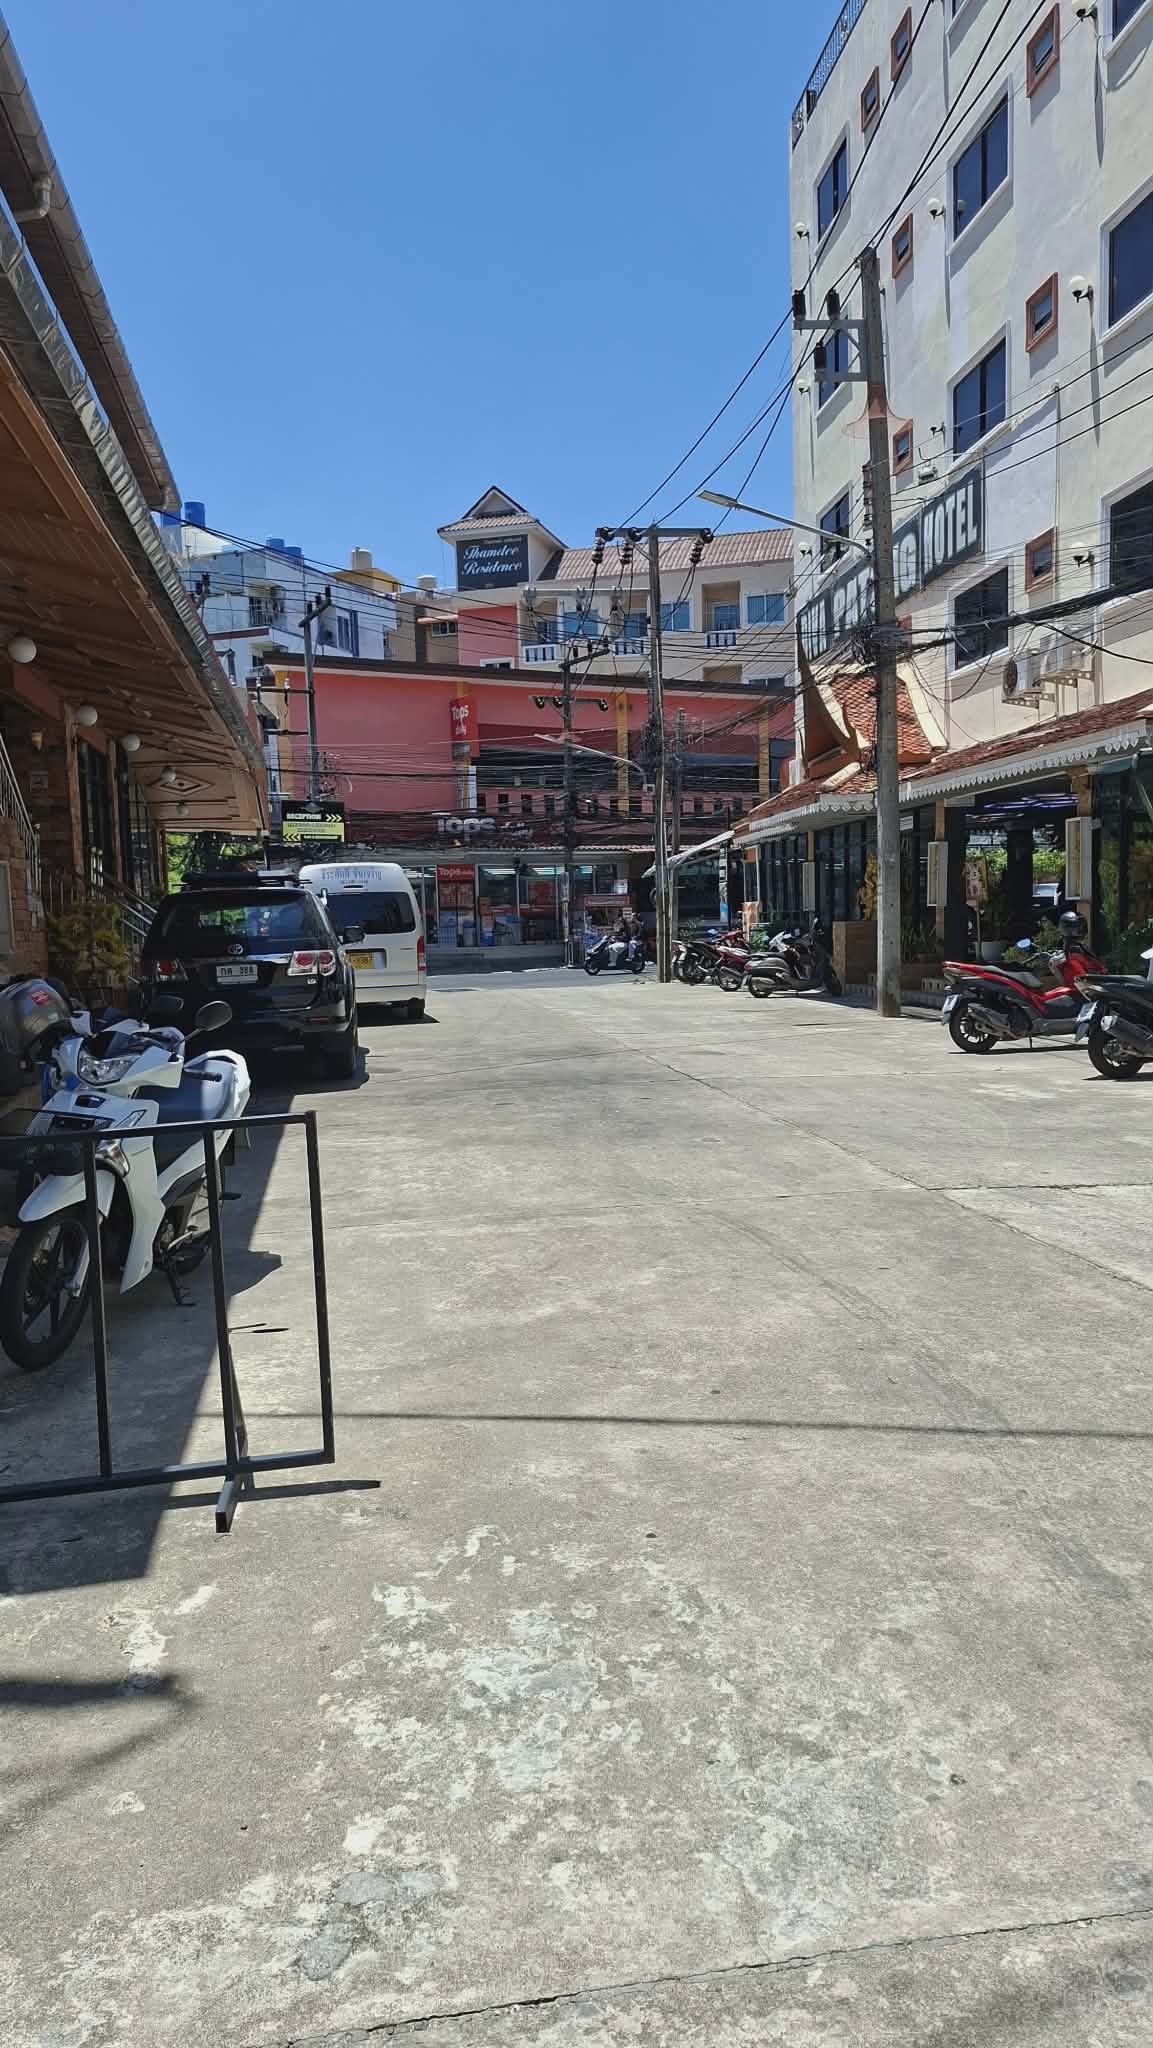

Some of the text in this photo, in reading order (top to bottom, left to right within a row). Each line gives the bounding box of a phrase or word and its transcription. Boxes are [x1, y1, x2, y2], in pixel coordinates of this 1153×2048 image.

[923, 479, 978, 576] HOTEL
[462, 560, 522, 576] Residence
[451, 704, 469, 721] Tops
